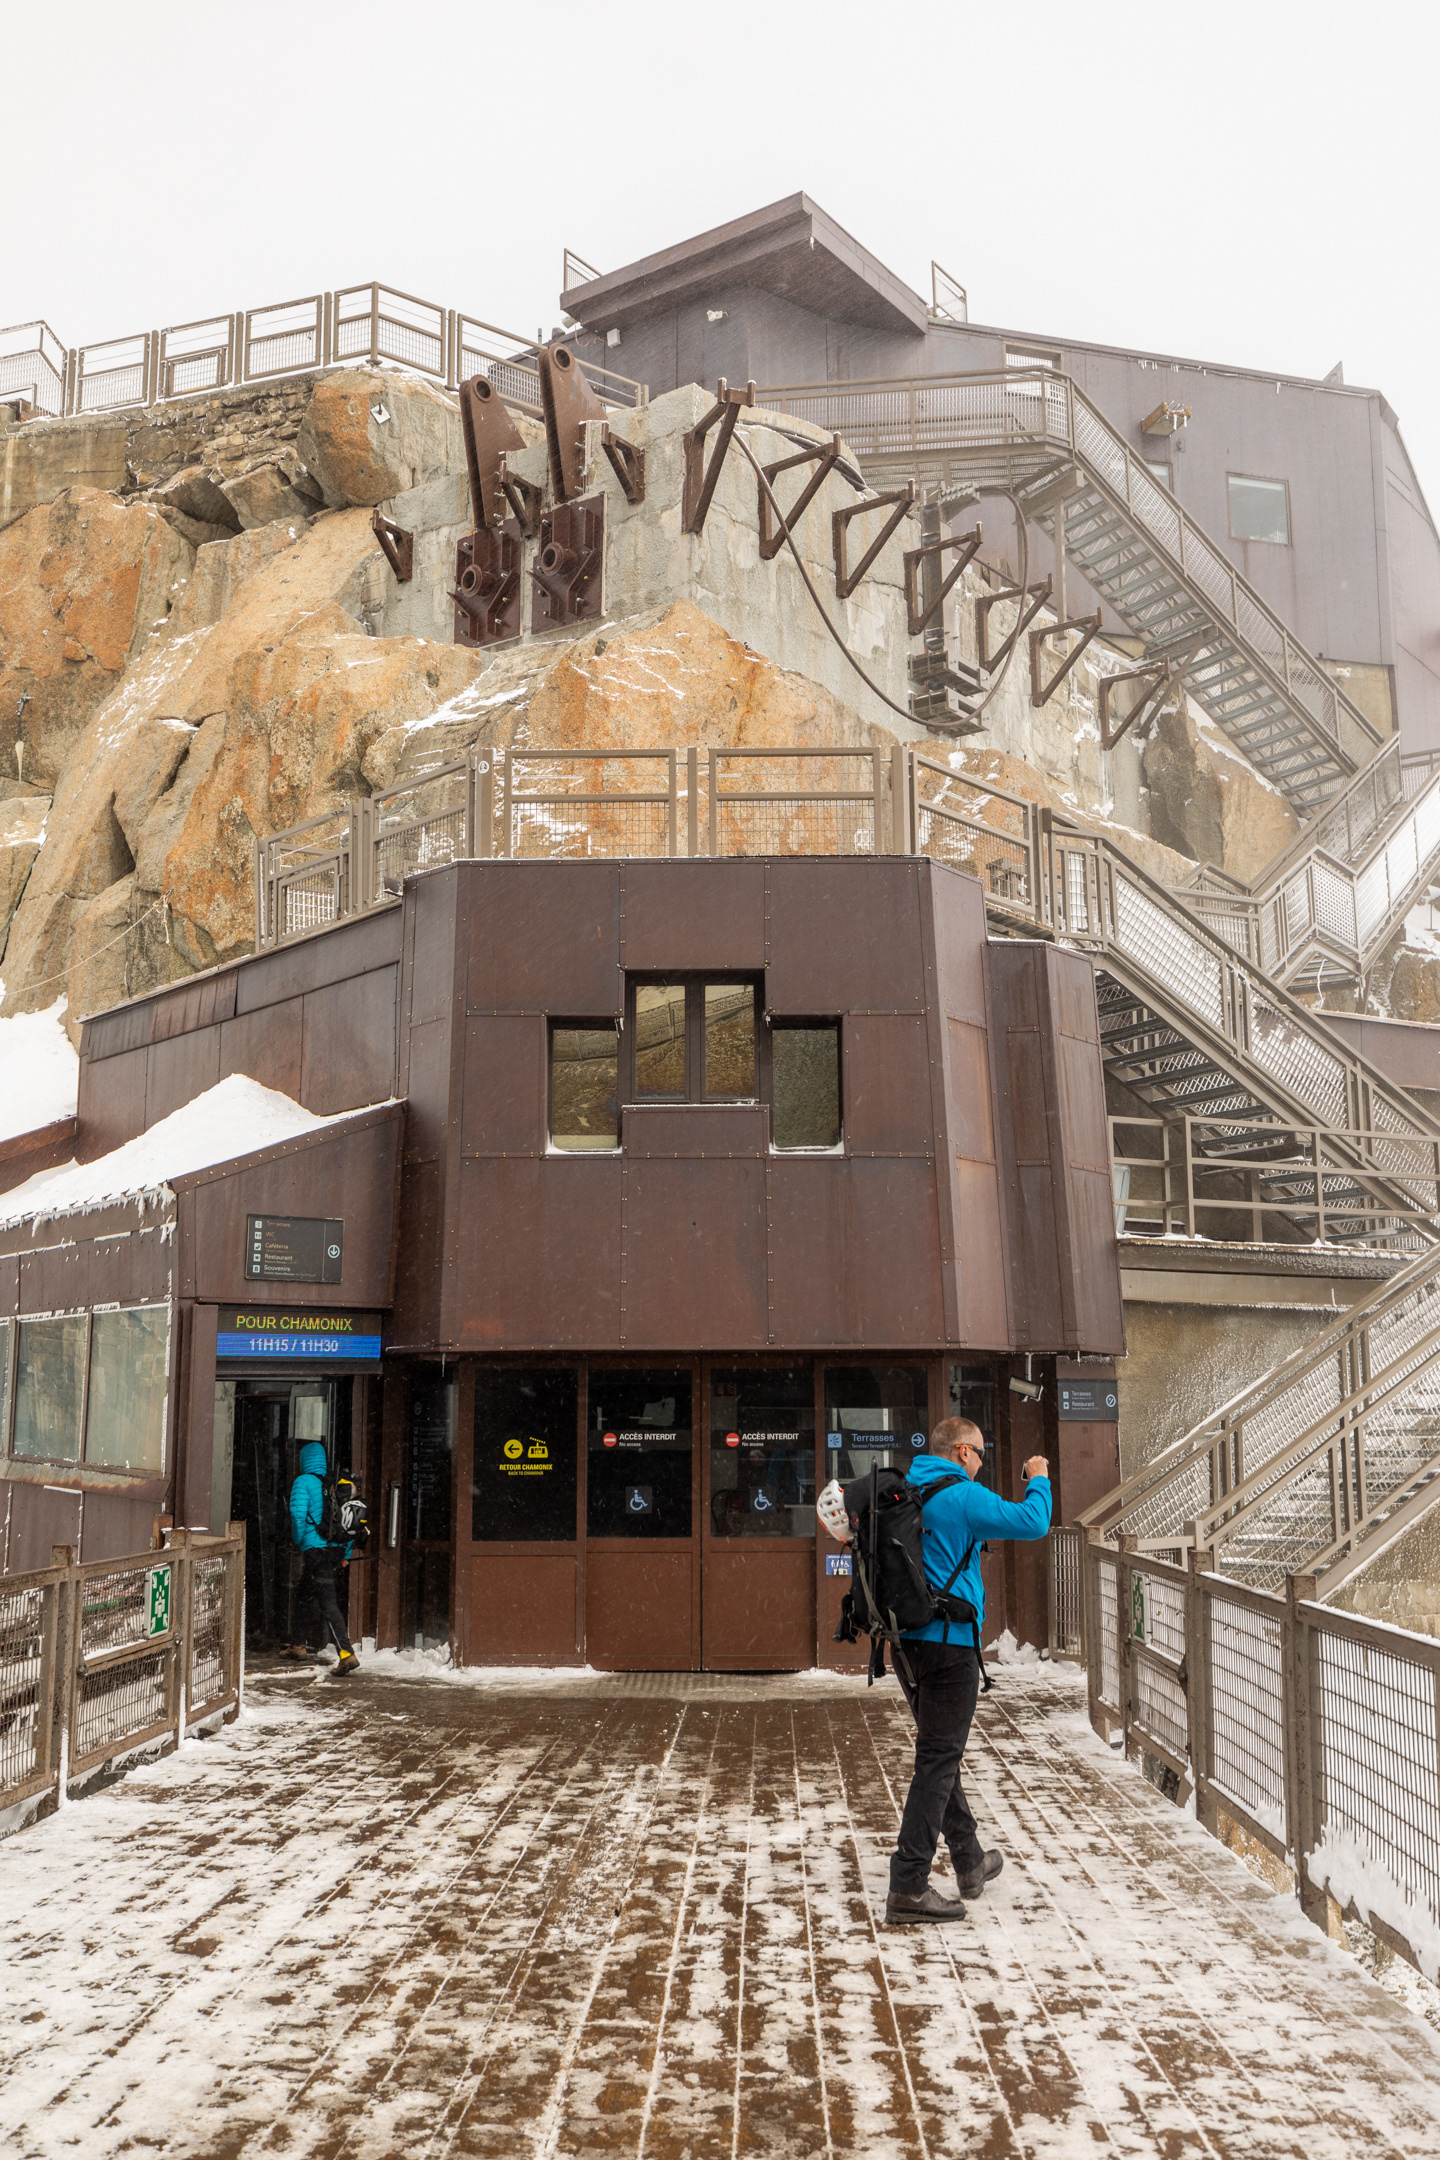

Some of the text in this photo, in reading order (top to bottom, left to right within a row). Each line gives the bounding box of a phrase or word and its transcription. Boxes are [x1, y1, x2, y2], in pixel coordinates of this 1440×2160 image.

[264, 1253, 293, 1261] Restaurant
[264, 1264, 291, 1272] Souvenirs
[236, 1315, 353, 1331] POUR CHAMONIX
[249, 1338, 289, 1352] 11H15
[299, 1339, 339, 1353] 11H30
[619, 1431, 677, 1441] ACCÈS INTERDIT
[741, 1431, 800, 1441] ACCÈS INTERDIT
[851, 1433, 895, 1442] Terrasses
